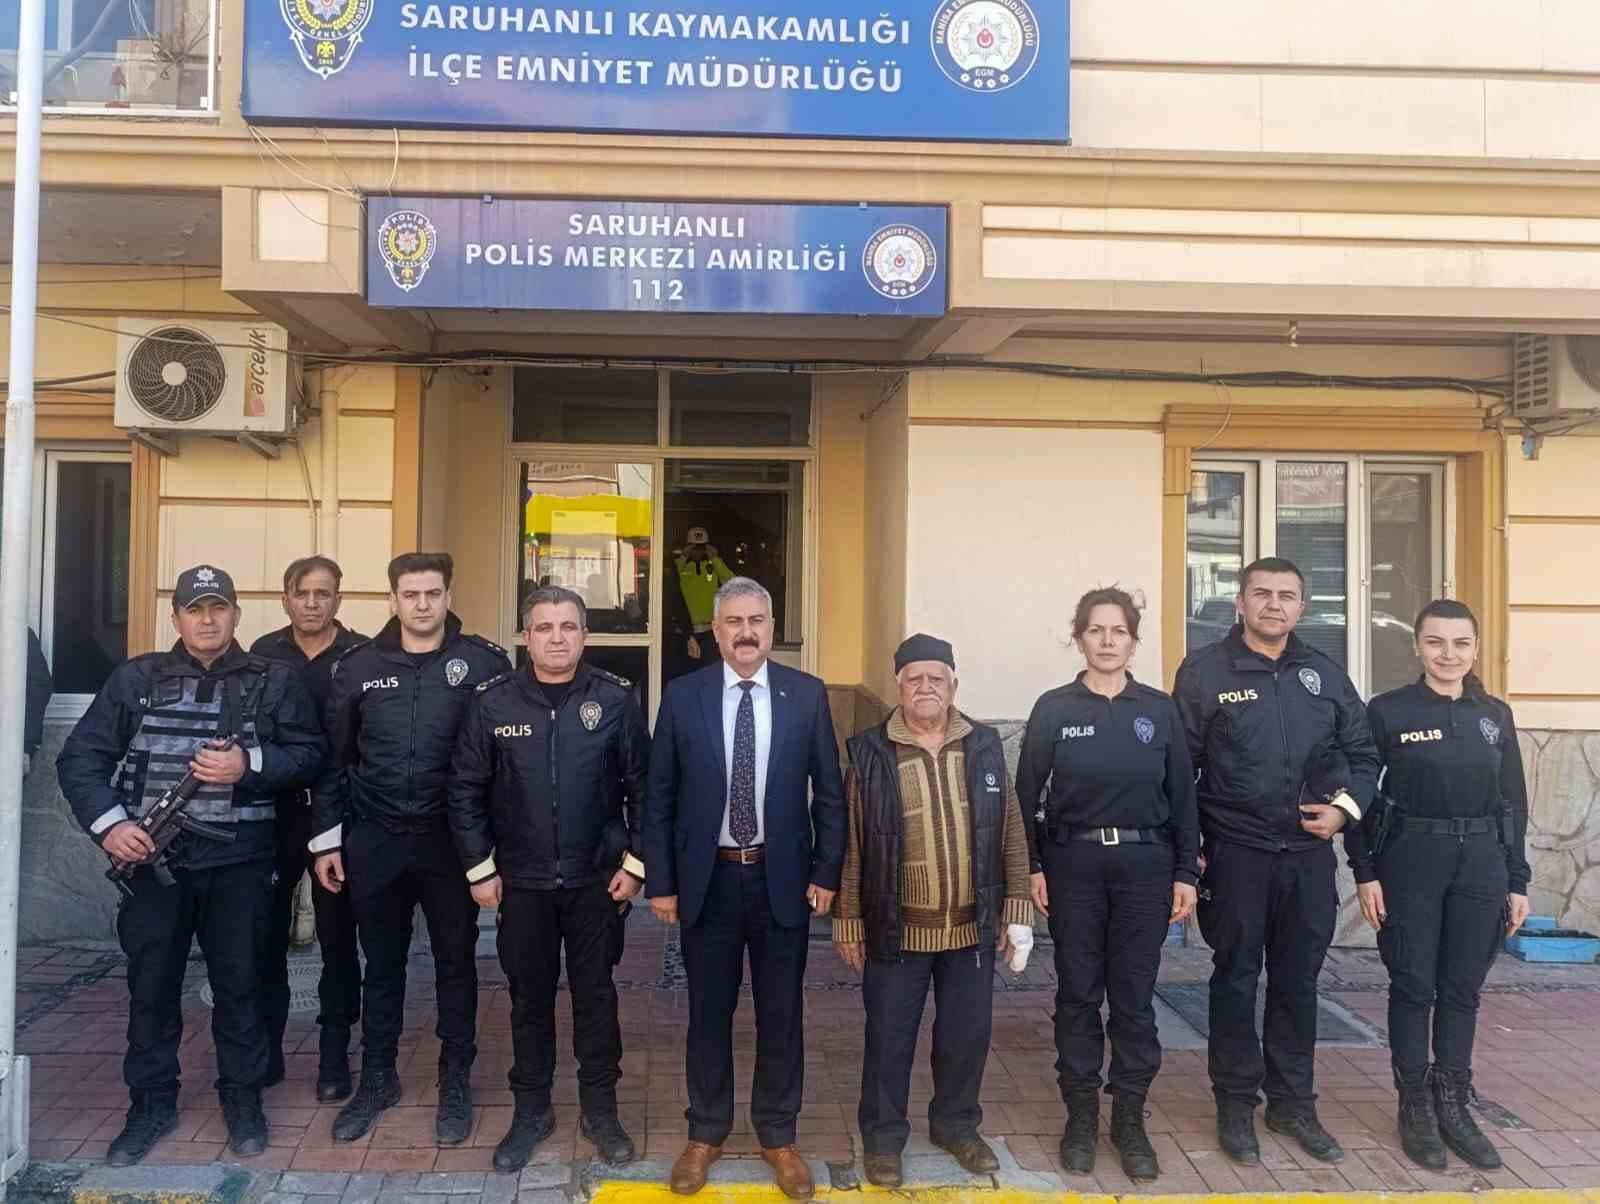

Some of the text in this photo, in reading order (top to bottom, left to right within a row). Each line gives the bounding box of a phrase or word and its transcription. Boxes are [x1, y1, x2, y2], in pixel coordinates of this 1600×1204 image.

[400, 3, 910, 45] SARUHANLI KAYMAKAMLIĞI
[408, 45, 902, 93] İLÇE EMNİYET MÜDÜRLÜĞÜ
[568, 213, 745, 238] SARUHANLI
[465, 238, 553, 267] POLİS
[564, 241, 695, 269] MERKEZİ
[706, 242, 846, 271] AMİRLİĞİ
[632, 278, 684, 300] 112
[248, 329, 269, 395] arçelik
